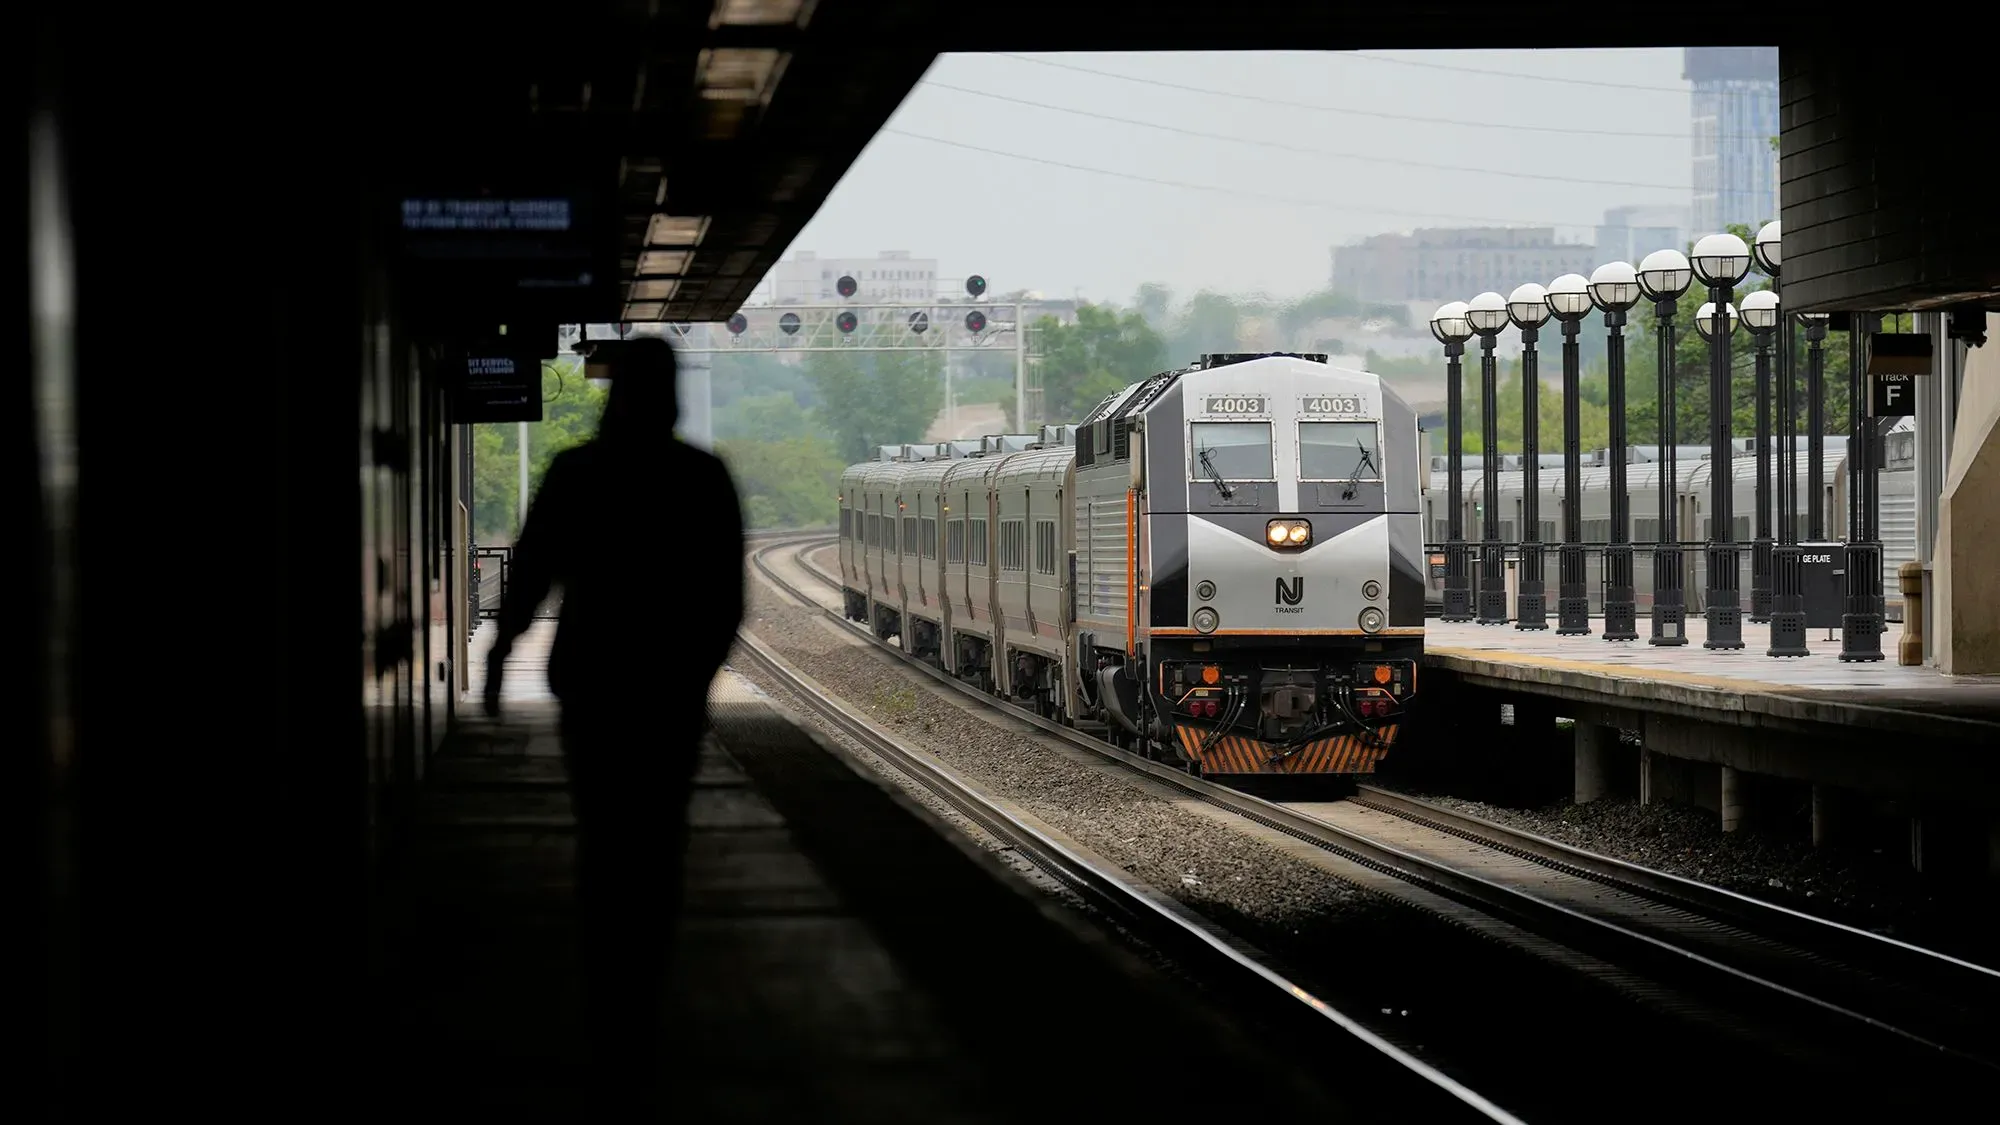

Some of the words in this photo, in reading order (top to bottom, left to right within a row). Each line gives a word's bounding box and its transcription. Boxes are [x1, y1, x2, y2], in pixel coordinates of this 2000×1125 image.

[1886, 385, 1902, 407] F
[1212, 398, 1259, 412] 4003
[1309, 398, 1355, 412] 4003
[1812, 554, 1831, 563] PLATE
[1275, 576, 1304, 605] NJ
